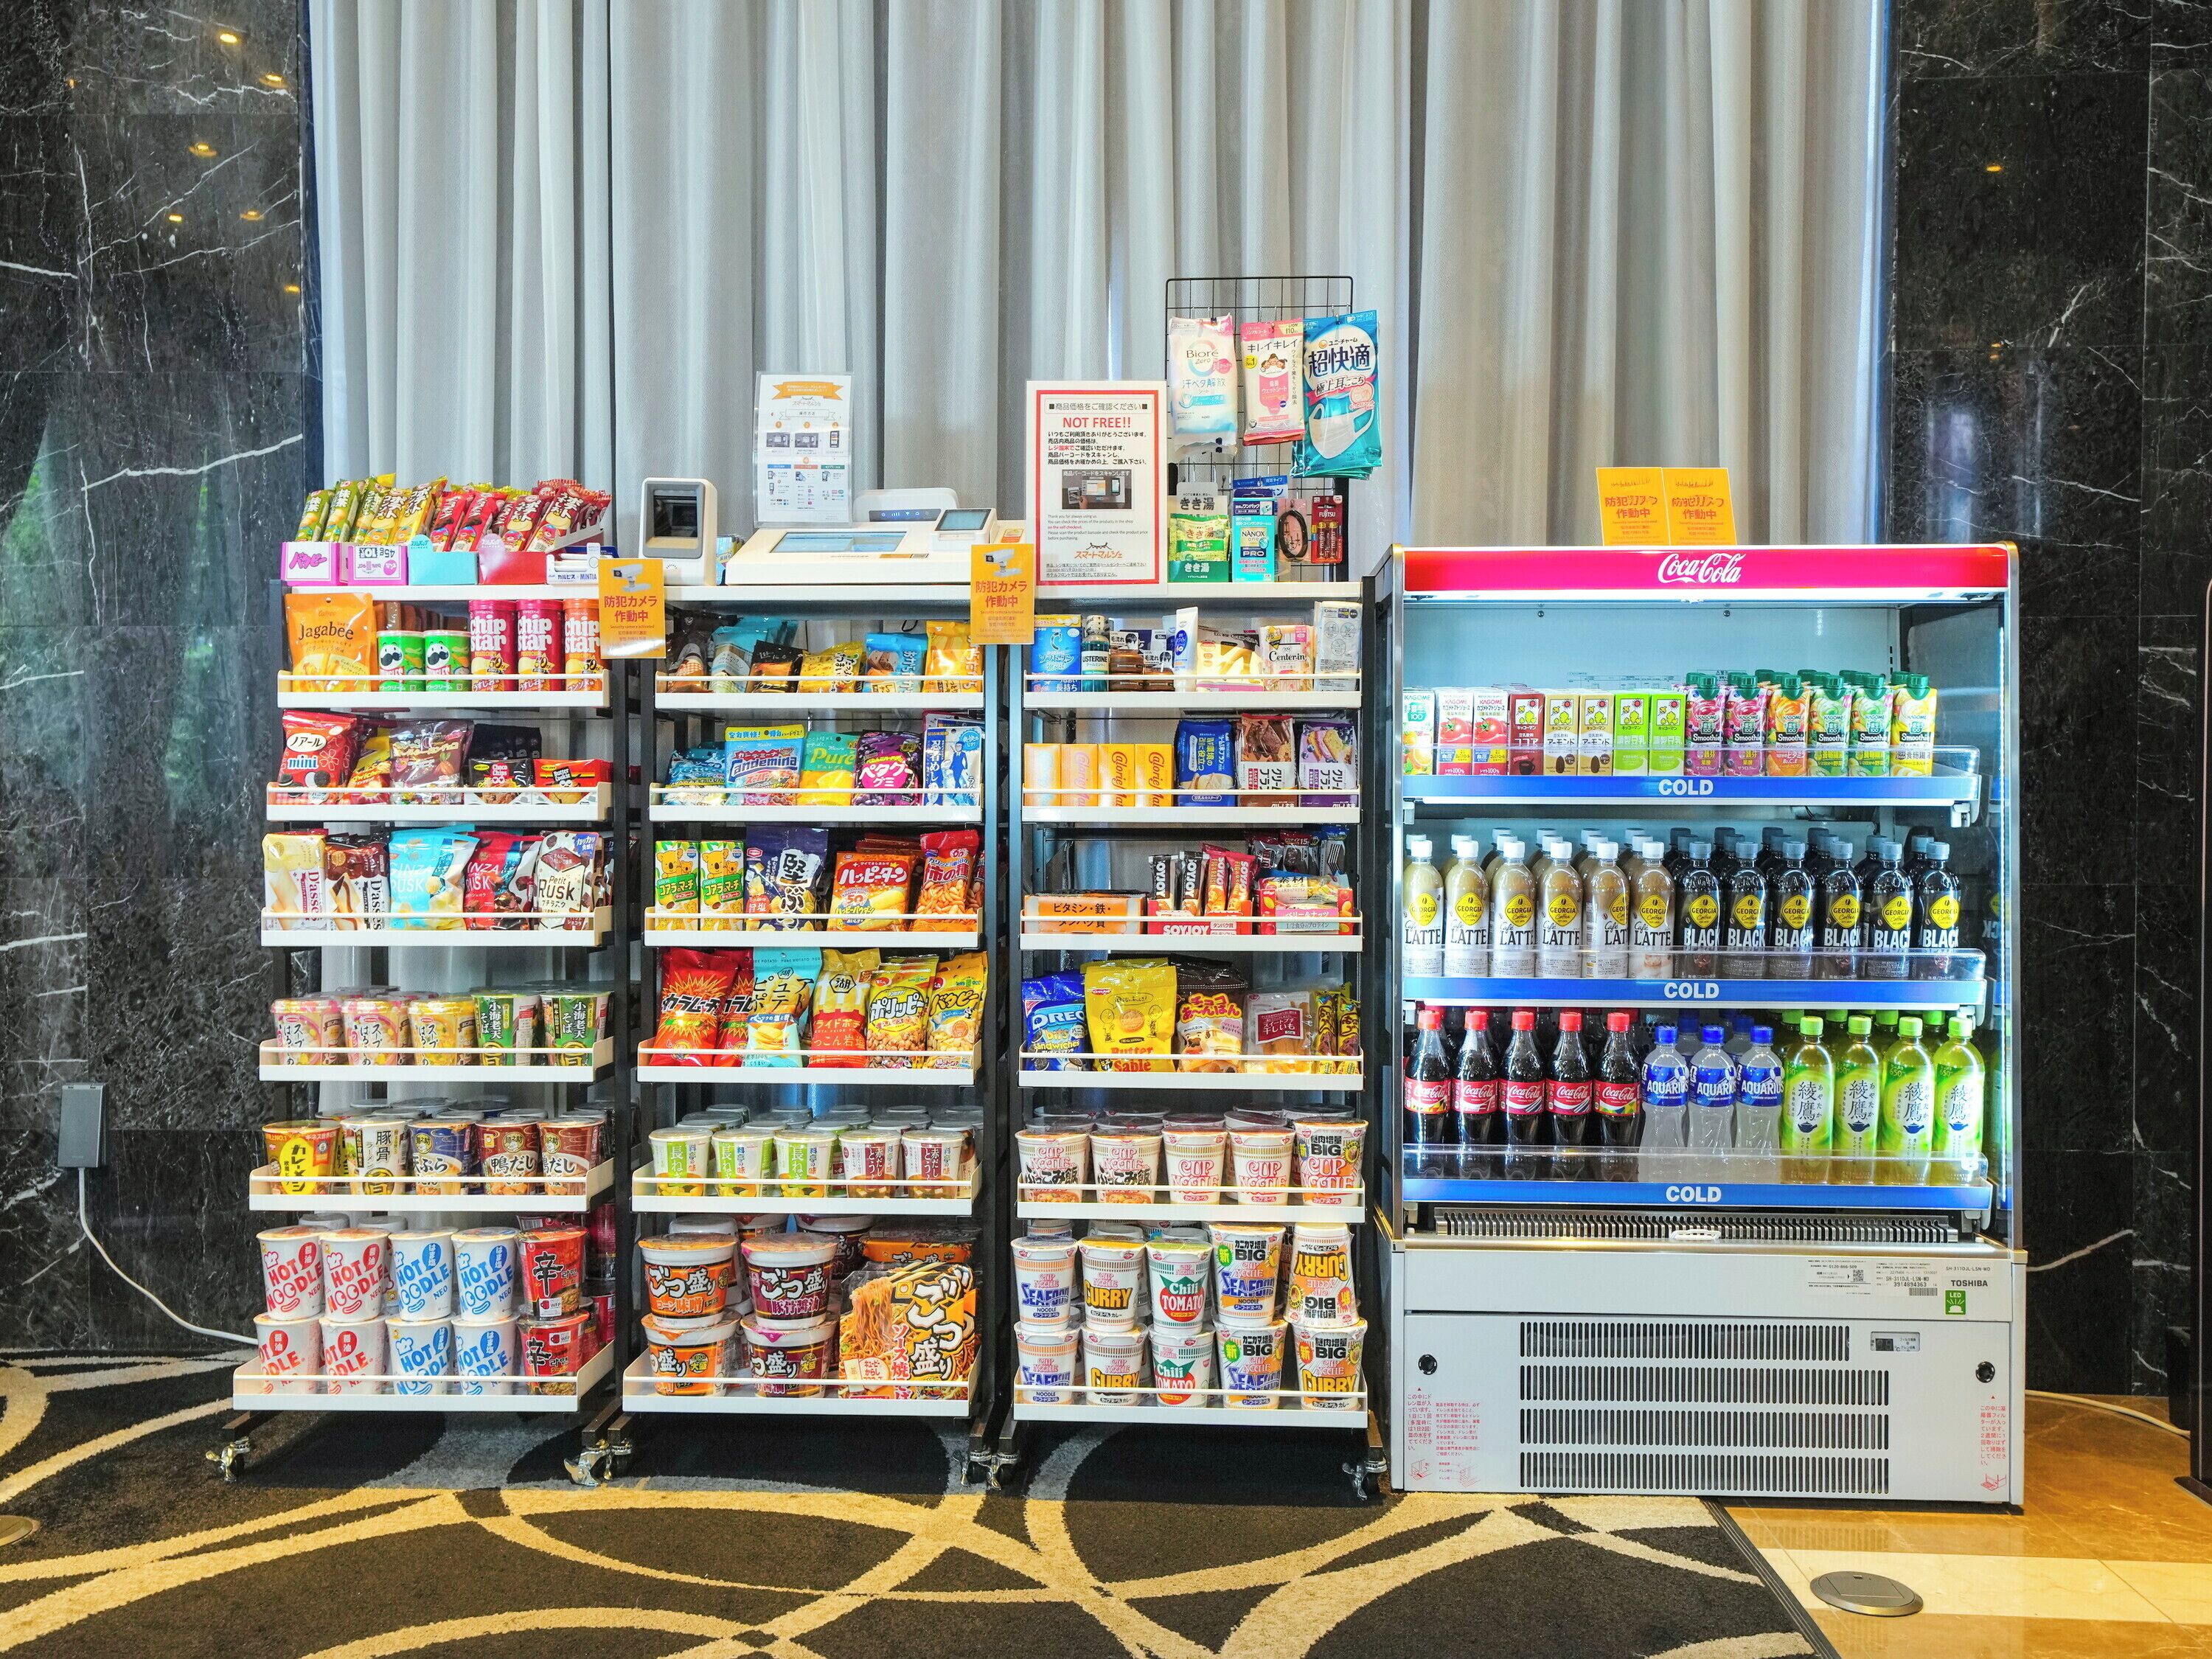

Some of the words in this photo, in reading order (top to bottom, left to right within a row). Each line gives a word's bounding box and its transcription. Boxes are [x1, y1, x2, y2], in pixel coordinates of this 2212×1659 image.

[1186, 349, 1218, 358] Bioré
[1248, 339, 1298, 353] キレイキレイ
[1309, 344, 1371, 378] 超快適
[1183, 378, 1225, 388] 汗ベタ解放
[1063, 417, 1088, 428] NOT
[1093, 417, 1130, 428] FREE!!
[1180, 497, 1214, 510] きき湯
[1186, 526, 1214, 538] きき湯
[1242, 530, 1265, 538] NANOX
[1074, 551, 1122, 559] スマートマルシェ
[1658, 553, 1745, 583] Coca-Cola
[975, 581, 1027, 593] 防犯カメラ
[604, 596, 657, 608] 防犯カメラ
[986, 596, 1018, 608] 作動中
[615, 611, 648, 622] 作動中
[299, 622, 354, 640] Jagabee
[470, 615, 507, 639] chip
[518, 615, 552, 639] chip
[470, 634, 507, 653] star
[518, 634, 552, 653] star
[290, 736, 323, 748] ノアール
[1514, 738, 1539, 747] ココア
[288, 755, 319, 769] mini
[929, 740, 939, 782] 忍者めし
[1112, 751, 1127, 788] Calorie
[1149, 751, 1164, 788] Calorie
[874, 777, 894, 787] グミ
[1658, 779, 1714, 796] COLD
[838, 869, 907, 885] ハッピーターン
[925, 864, 970, 882] 柿の種
[1405, 928, 1441, 945] LATTE
[1450, 928, 1487, 945] LATTE
[1500, 931, 1534, 945] LATTE
[1634, 931, 1671, 946] LATTE
[1684, 928, 1720, 947] BLACK
[1728, 928, 1765, 947] BLACK
[1824, 928, 1860, 947] BLACK
[754, 976, 815, 994] ピュア
[1663, 982, 1719, 998] COLD
[481, 1012, 490, 1034] そば
[489, 1000, 501, 1039] 小海老天
[563, 1012, 572, 1034] そば
[573, 1001, 586, 1039] 小海老天
[1032, 1010, 1085, 1030] OREO
[1263, 1024, 1295, 1034] 干しいも
[1509, 1085, 1540, 1099] Coca-Cola
[1557, 1085, 1588, 1099] Coca-Cola
[1602, 1085, 1635, 1100] Coca-Cola
[1646, 1079, 1688, 1095] AQUARIUS
[1742, 1079, 1784, 1094] AQUARIUS
[1797, 1081, 1817, 1121] 綾鷹
[1848, 1079, 1869, 1120] 綾鷹
[1903, 1082, 1924, 1121] 綾鷹
[376, 1130, 392, 1162] 豚骨
[1311, 1144, 1341, 1156] BIG
[491, 1156, 535, 1174] 鴨だし
[688, 1144, 696, 1172] 料亭の味
[737, 1147, 745, 1174] 料亭の味
[875, 1147, 883, 1177] 赤だし
[931, 1147, 939, 1177] 赤だし
[1178, 1160, 1214, 1177] CUP
[1246, 1161, 1282, 1177] CUP
[1308, 1158, 1346, 1177] CUP
[1666, 1186, 1722, 1202] COLD
[1219, 1249, 1229, 1262] 新
[1235, 1249, 1266, 1262] BIG
[268, 1259, 299, 1287] HOT
[331, 1261, 361, 1287] HOT
[532, 1251, 563, 1298] 辛
[1295, 1252, 1349, 1281] CURRY
[460, 1262, 489, 1289] HOT
[648, 1265, 716, 1298] ごつ盛り
[761, 1267, 828, 1300] ごつ盛り
[308, 1285, 321, 1298] NEO
[370, 1286, 381, 1299] NEO
[1169, 1283, 1199, 1295] Chili
[1220, 1271, 1275, 1298] SEAFOOD
[498, 1287, 512, 1302] NEO
[1084, 1280, 1133, 1310] CURRY
[1162, 1295, 1203, 1311] TOMATO
[400, 1344, 432, 1372] HOT
[526, 1337, 552, 1377] 辛
[1225, 1346, 1237, 1358] 新
[1243, 1344, 1273, 1356] BIG
[1315, 1347, 1346, 1359] BIG
[549, 1357, 568, 1367] 라면
[1158, 1363, 1183, 1377] Chili
